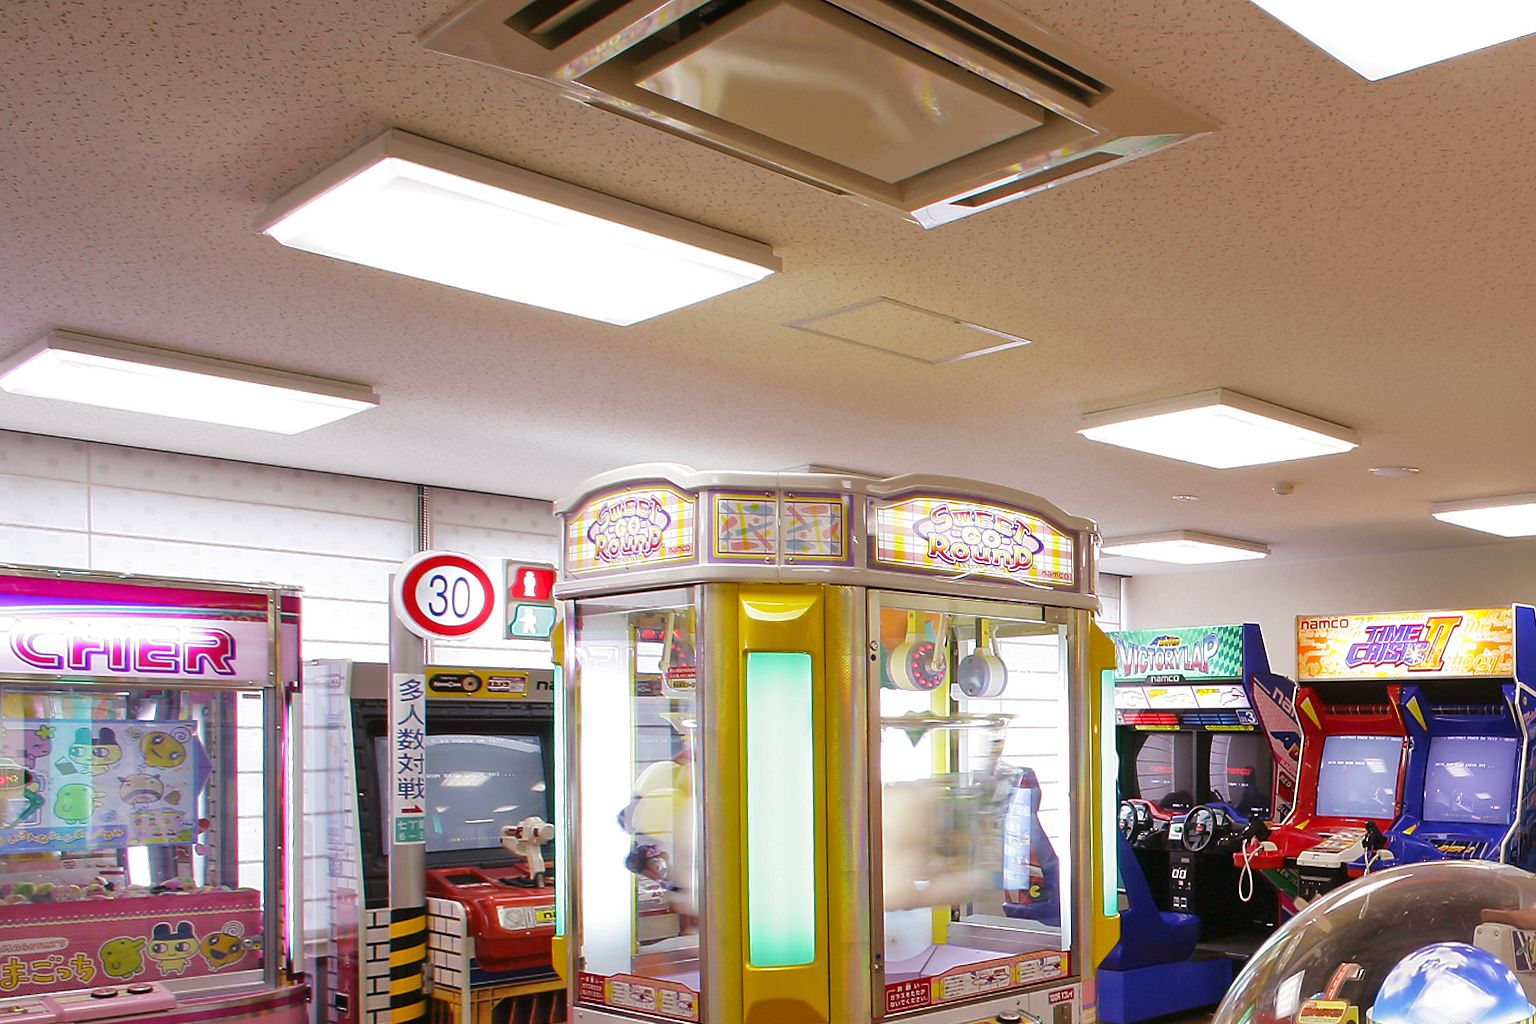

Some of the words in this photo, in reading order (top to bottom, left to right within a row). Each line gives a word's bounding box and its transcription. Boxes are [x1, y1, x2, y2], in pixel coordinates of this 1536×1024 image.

[929, 504, 1032, 543] SWEET
[429, 574, 471, 619] 30
[1300, 618, 1349, 631] namco
[1364, 624, 1424, 644] TIME
[1114, 635, 1184, 677] VICTORY
[1184, 632, 1219, 675] LAP
[1346, 641, 1430, 669] CRISIS
[1150, 675, 1180, 683] namco
[397, 678, 425, 800] 多人数対戦
[0, 952, 97, 991] まごっち
